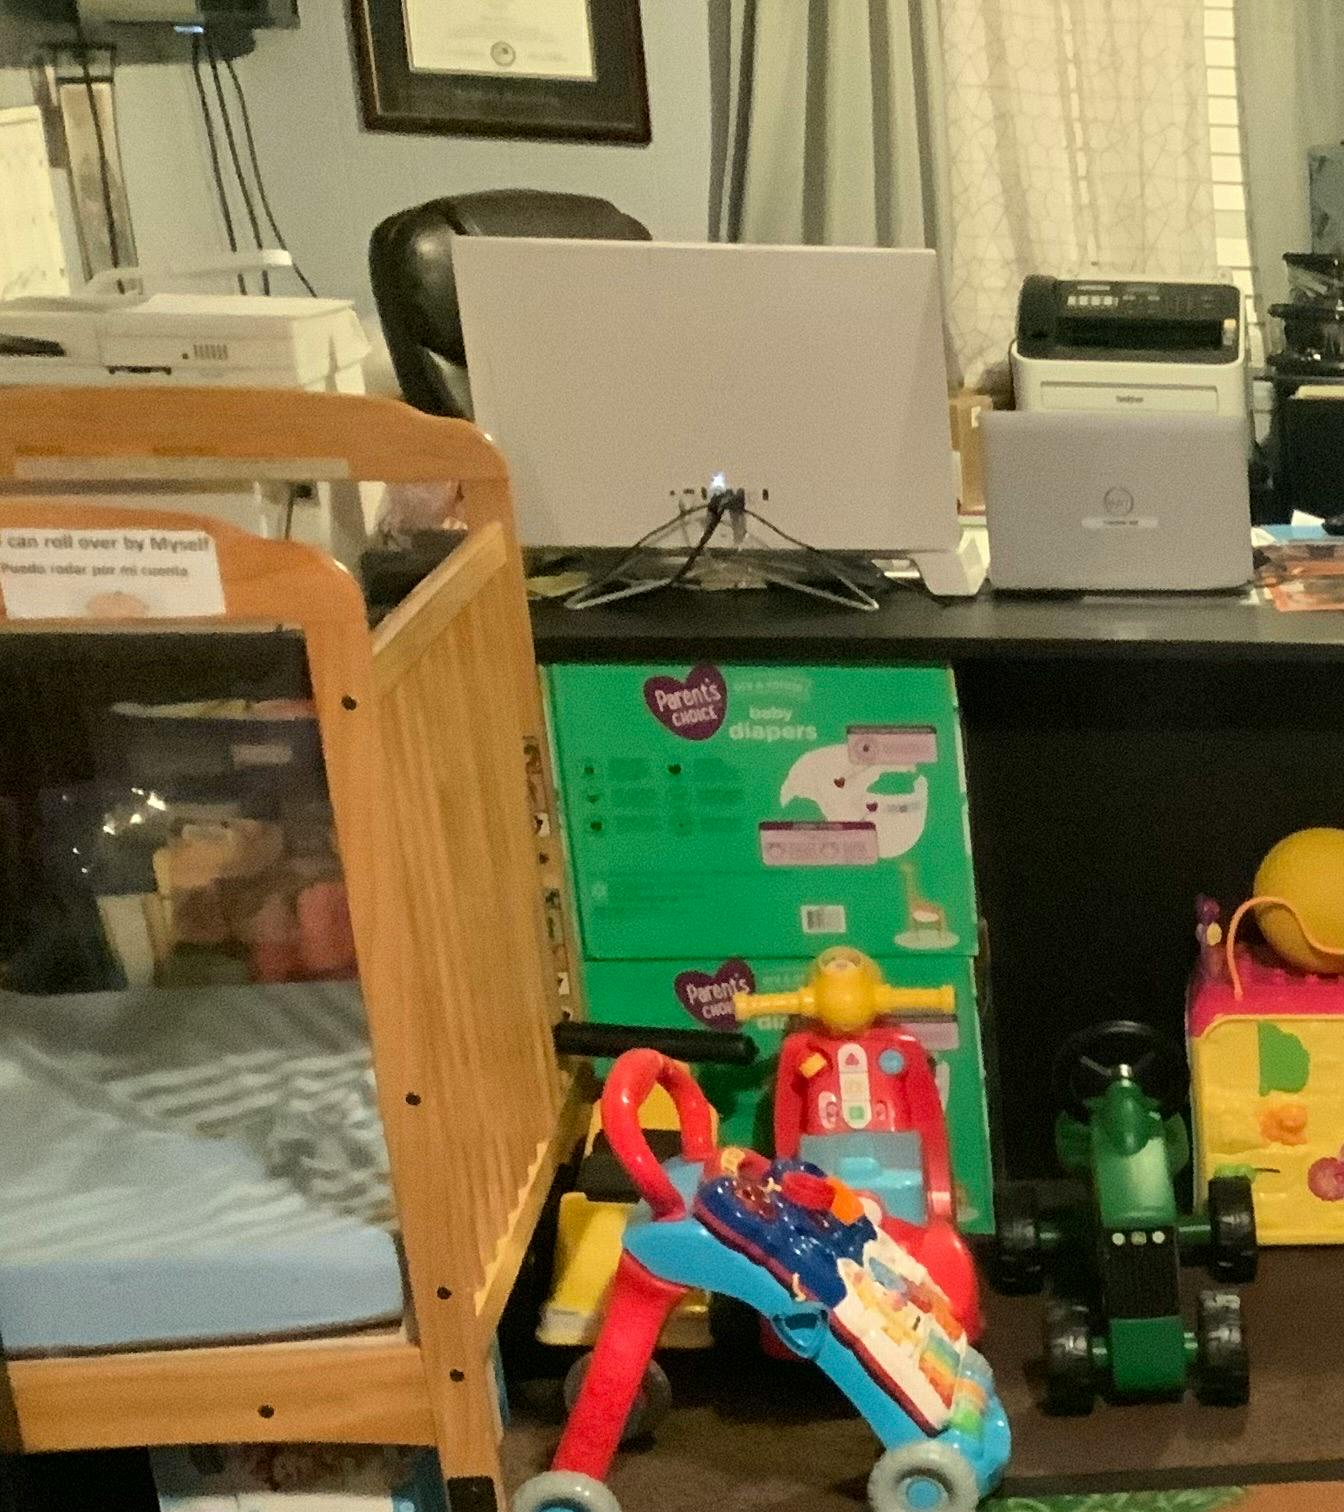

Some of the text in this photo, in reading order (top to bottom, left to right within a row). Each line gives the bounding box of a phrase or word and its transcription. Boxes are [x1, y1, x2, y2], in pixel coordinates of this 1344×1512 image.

[654, 678, 722, 712] Parent's
[671, 704, 718, 727] CHOICE
[750, 706, 792, 722] baby
[728, 722, 817, 743] diapers
